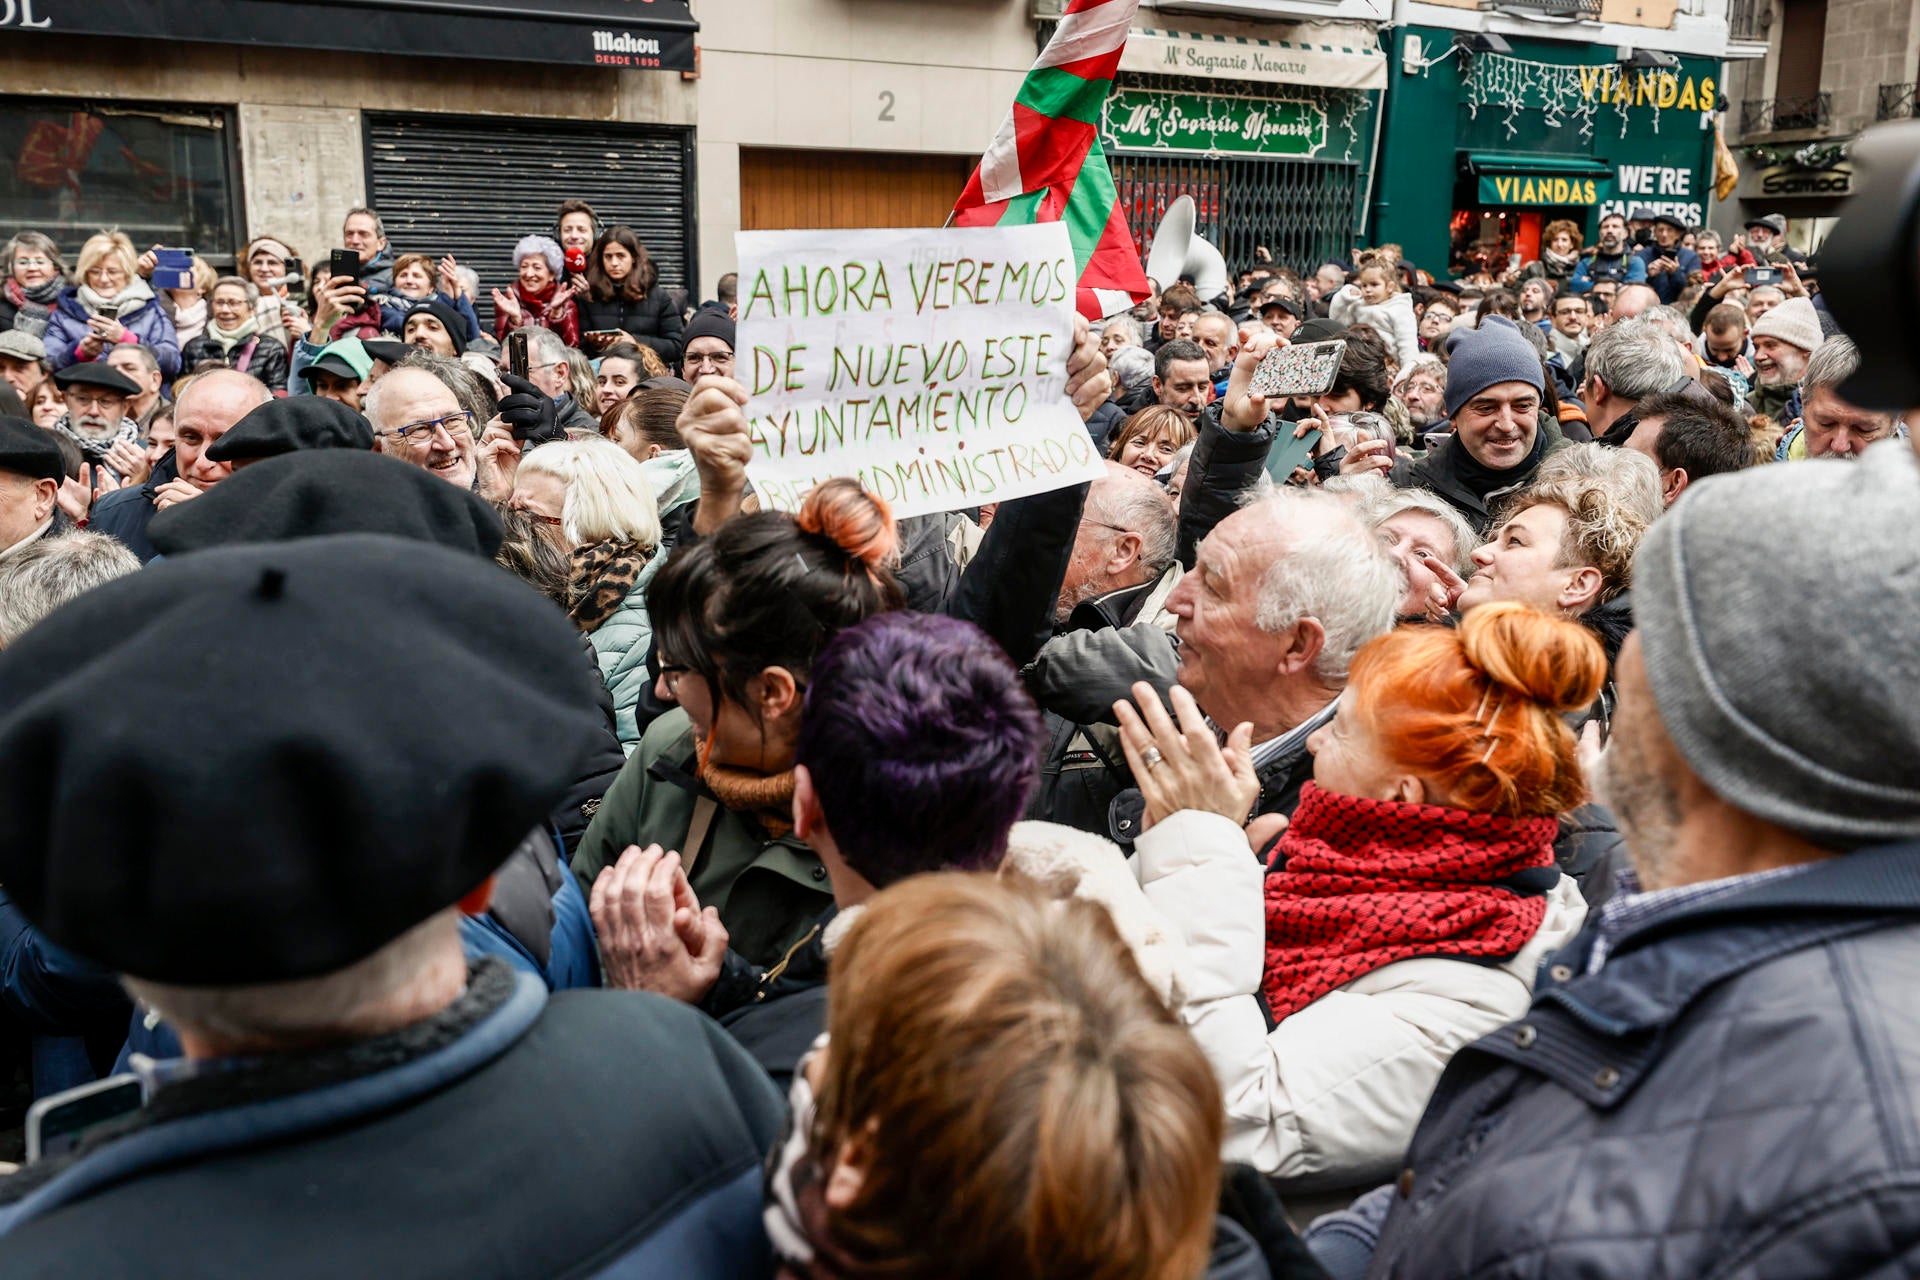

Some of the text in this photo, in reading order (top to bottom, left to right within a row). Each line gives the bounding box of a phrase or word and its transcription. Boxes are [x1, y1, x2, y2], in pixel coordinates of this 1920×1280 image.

[592, 30, 661, 55] Mahou
[595, 53, 661, 67] DESDE 1890
[1579, 64, 1715, 112] VIANDAS
[878, 90, 896, 122] 2
[1162, 106, 1240, 137] Sagrario
[1241, 111, 1313, 141] Navarro
[1495, 176, 1597, 205] VIANDAS
[743, 257, 1066, 320] AHORA VEREMOS
[751, 343, 808, 396] DE
[828, 339, 968, 392] NUEVO
[981, 333, 1053, 381] ESTE
[750, 381, 1027, 458] AYUNTAMIENTO
